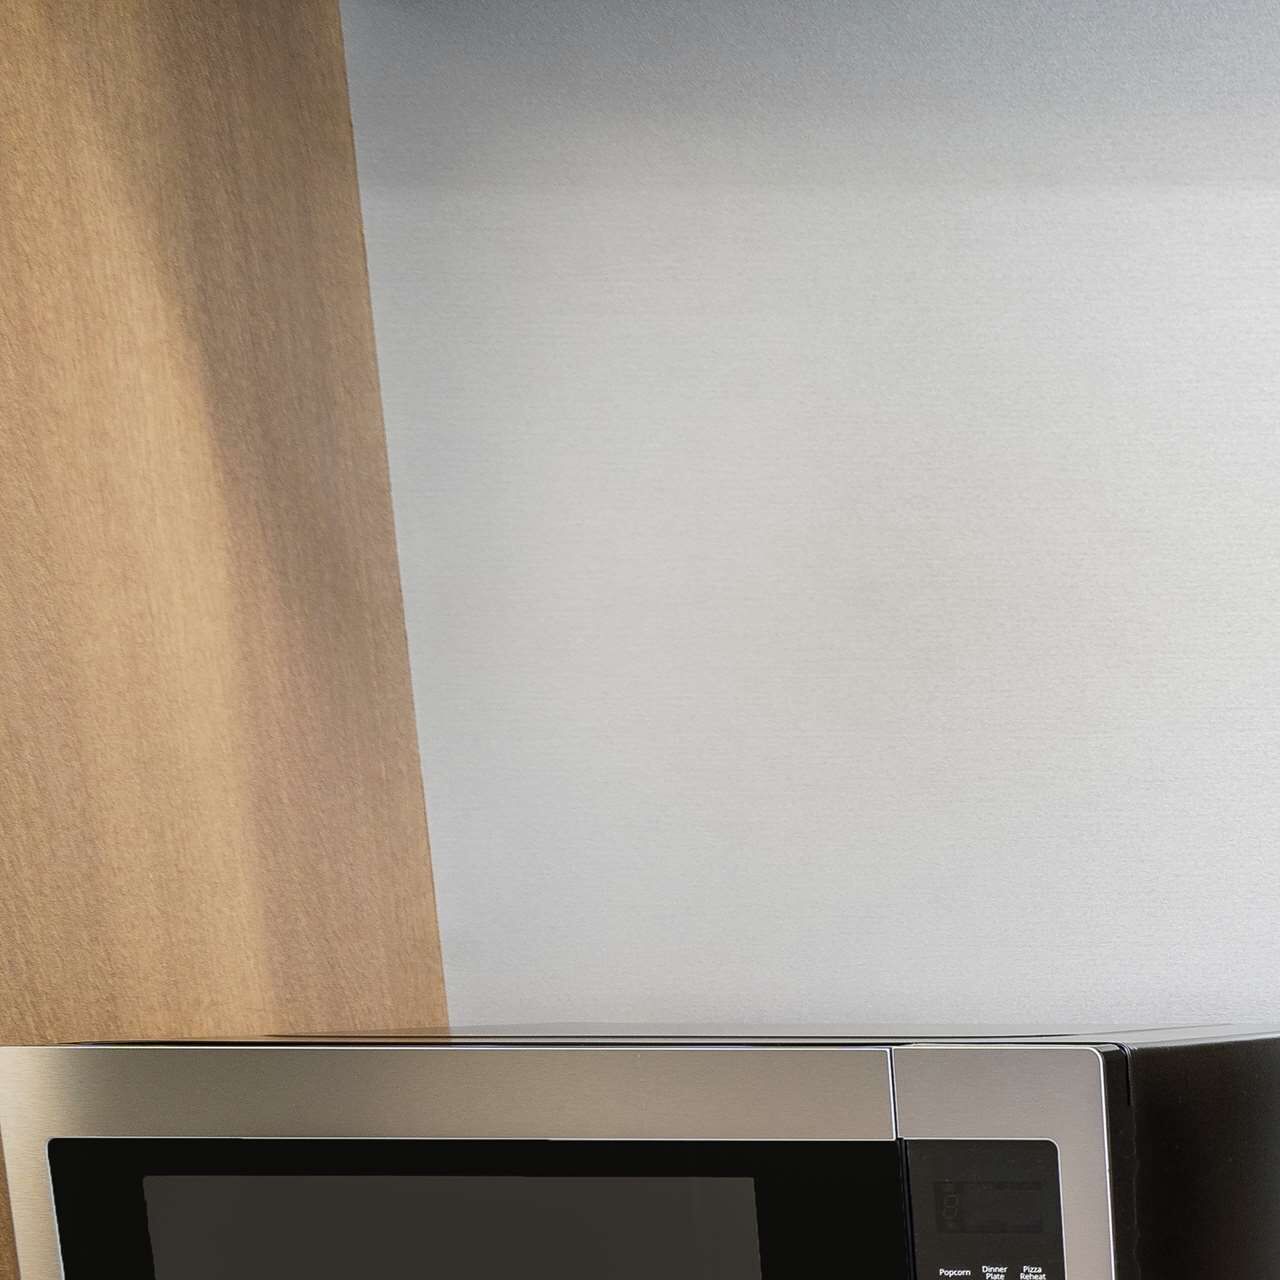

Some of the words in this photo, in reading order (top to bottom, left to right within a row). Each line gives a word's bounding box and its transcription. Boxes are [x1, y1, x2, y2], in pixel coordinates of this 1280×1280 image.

[939, 1268, 971, 1278] Popcorn
[982, 1265, 1008, 1273] Dinner
[1023, 1265, 1042, 1273] Pizza
